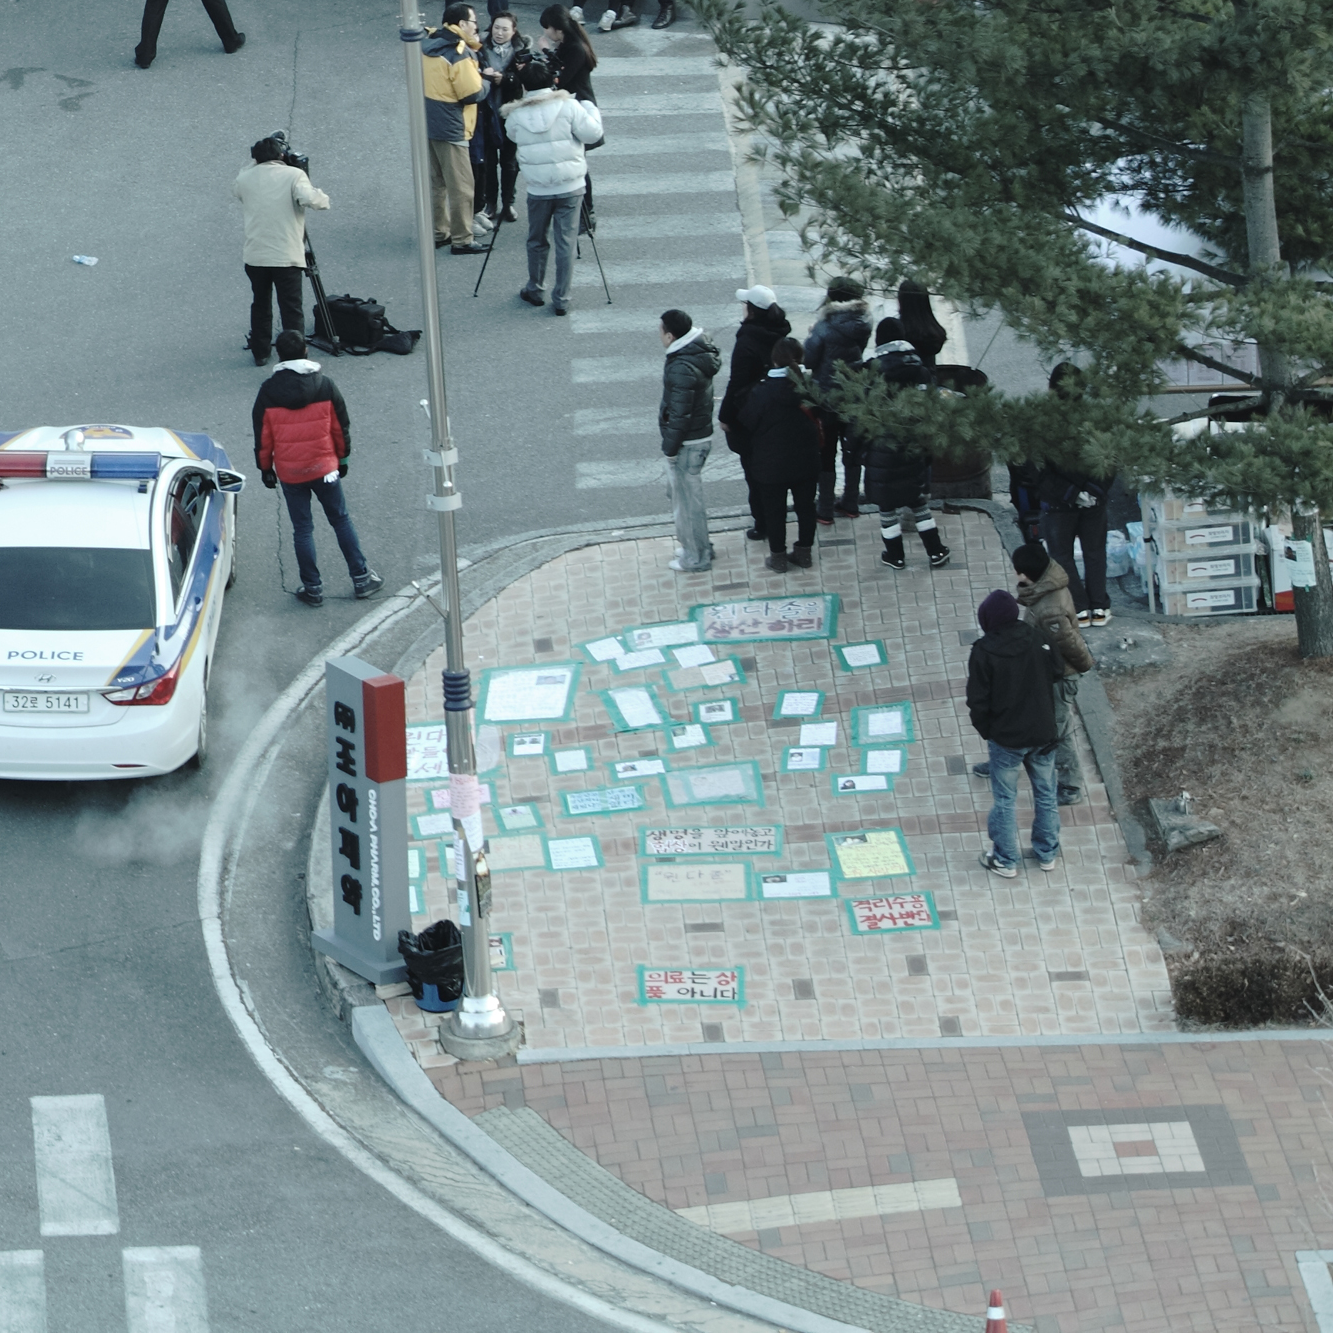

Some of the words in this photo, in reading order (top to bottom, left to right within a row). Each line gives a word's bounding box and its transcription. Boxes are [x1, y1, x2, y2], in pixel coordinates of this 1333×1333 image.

[50, 466, 88, 476] POLICE
[7, 650, 84, 661] POLICE
[45, 696, 80, 709] 5141
[647, 828, 703, 840] 생명을
[714, 827, 775, 839] 앞에놓고
[853, 895, 925, 914] 격리수용
[648, 971, 711, 985] 의료는
[677, 987, 737, 1000] 아니다
